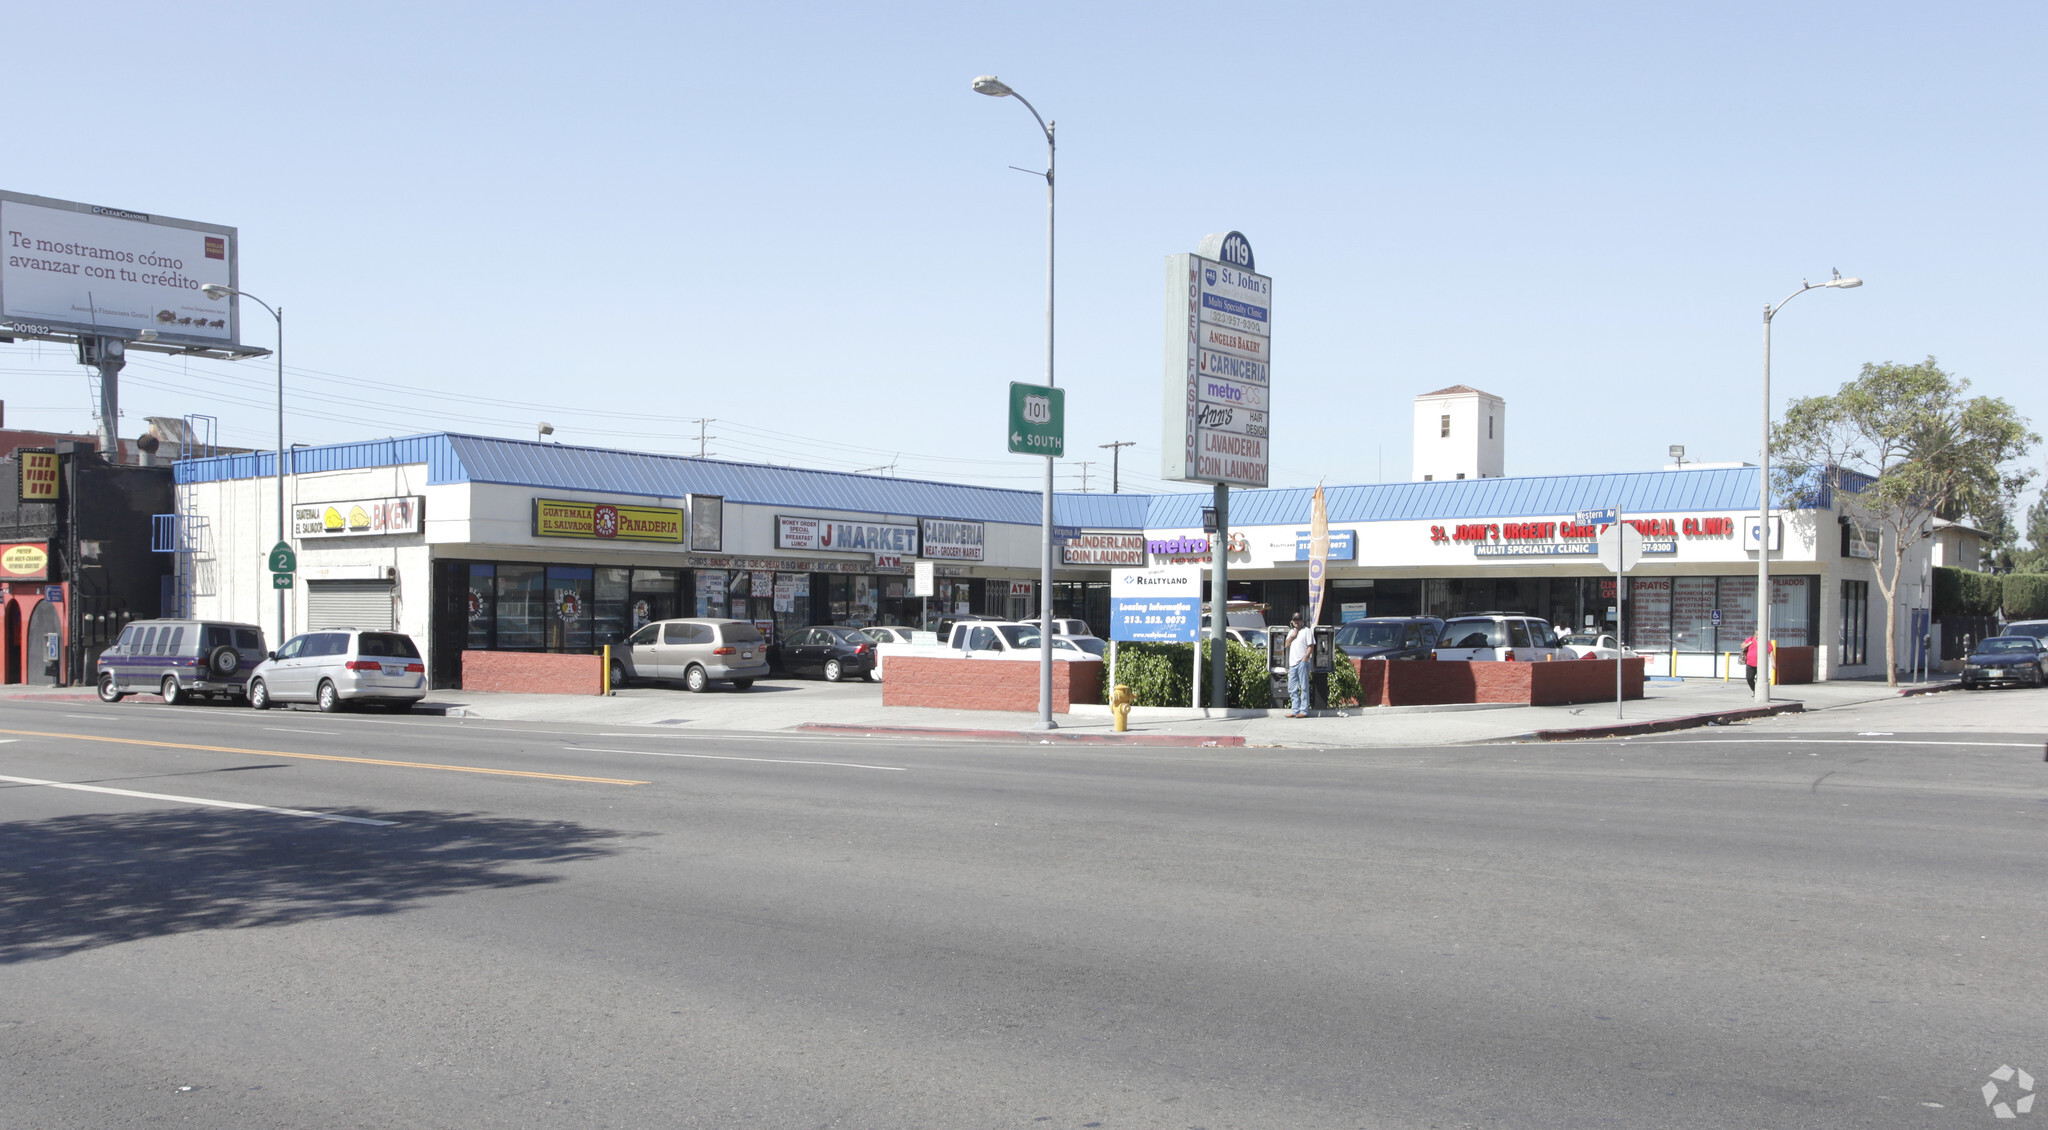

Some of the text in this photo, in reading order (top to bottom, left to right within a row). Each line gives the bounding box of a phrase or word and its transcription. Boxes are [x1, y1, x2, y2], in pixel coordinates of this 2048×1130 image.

[9, 231, 183, 269] Te mostramos cómo
[1225, 236, 1249, 266] 1119
[9, 256, 199, 290] avanzar con tu crédito
[1222, 268, 1267, 294] St. John's
[1208, 296, 1263, 319] Multi Specialty Clinic
[13, 322, 49, 335] 001932
[1187, 269, 1198, 464] WOMEN FASHION
[1201, 352, 1267, 383] J CARNICERIA
[1208, 383, 1261, 405] metroPCS
[1029, 402, 1046, 418] 101
[1198, 404, 1263, 427] Ann's HAIR
[1246, 423, 1267, 436] DESIGN
[1027, 434, 1062, 449] SOUTH
[1205, 433, 1261, 458] LAVANDERIA
[31, 456, 51, 468] XXX
[1198, 455, 1267, 481] COIN LAUNDRY
[27, 469, 56, 481] VIDEO
[31, 483, 52, 494] DVD
[296, 509, 320, 520] GUATEMALA
[373, 502, 415, 531] BAKERY
[543, 508, 592, 519] GUATEMALA
[1204, 513, 1217, 526] ATM
[1577, 509, 1615, 520] Western Av
[296, 522, 323, 534] EL SALVADOR
[543, 520, 592, 531] EL SALVADOR
[619, 515, 678, 533] PANADERIA
[1452, 523, 1499, 540] JOHN'S
[1503, 522, 1556, 539] URGENT
[1560, 521, 1597, 538] CARE
[1683, 517, 1733, 536] CLINIC
[821, 524, 916, 551] J MARKET
[925, 521, 982, 545] CARNICERIA
[1054, 527, 1080, 538] Virginia Av
[1067, 536, 1142, 548] AUNDERLAND
[925, 545, 938, 556] MEAT
[941, 546, 962, 557] GROCERY
[1477, 546, 1505, 554] MULTI
[1507, 545, 1555, 554] SPECIALTY
[1557, 544, 1589, 553] CLINIC
[278, 554, 287, 568] 2
[688, 557, 707, 566] CHIPS
[710, 557, 731, 566] SNACK
[734, 559, 746, 567] ICE
[878, 557, 900, 567] ATM
[1065, 550, 1142, 562] COIN LAUNDRY
[1137, 577, 1188, 585] REALTYLAND
[1632, 582, 1669, 590] GRATIS
[1011, 584, 1030, 593] ATM
[1603, 590, 1616, 598] OPE
[1119, 603, 1191, 613] Leasing Information
[1165, 616, 1186, 624] 0073
